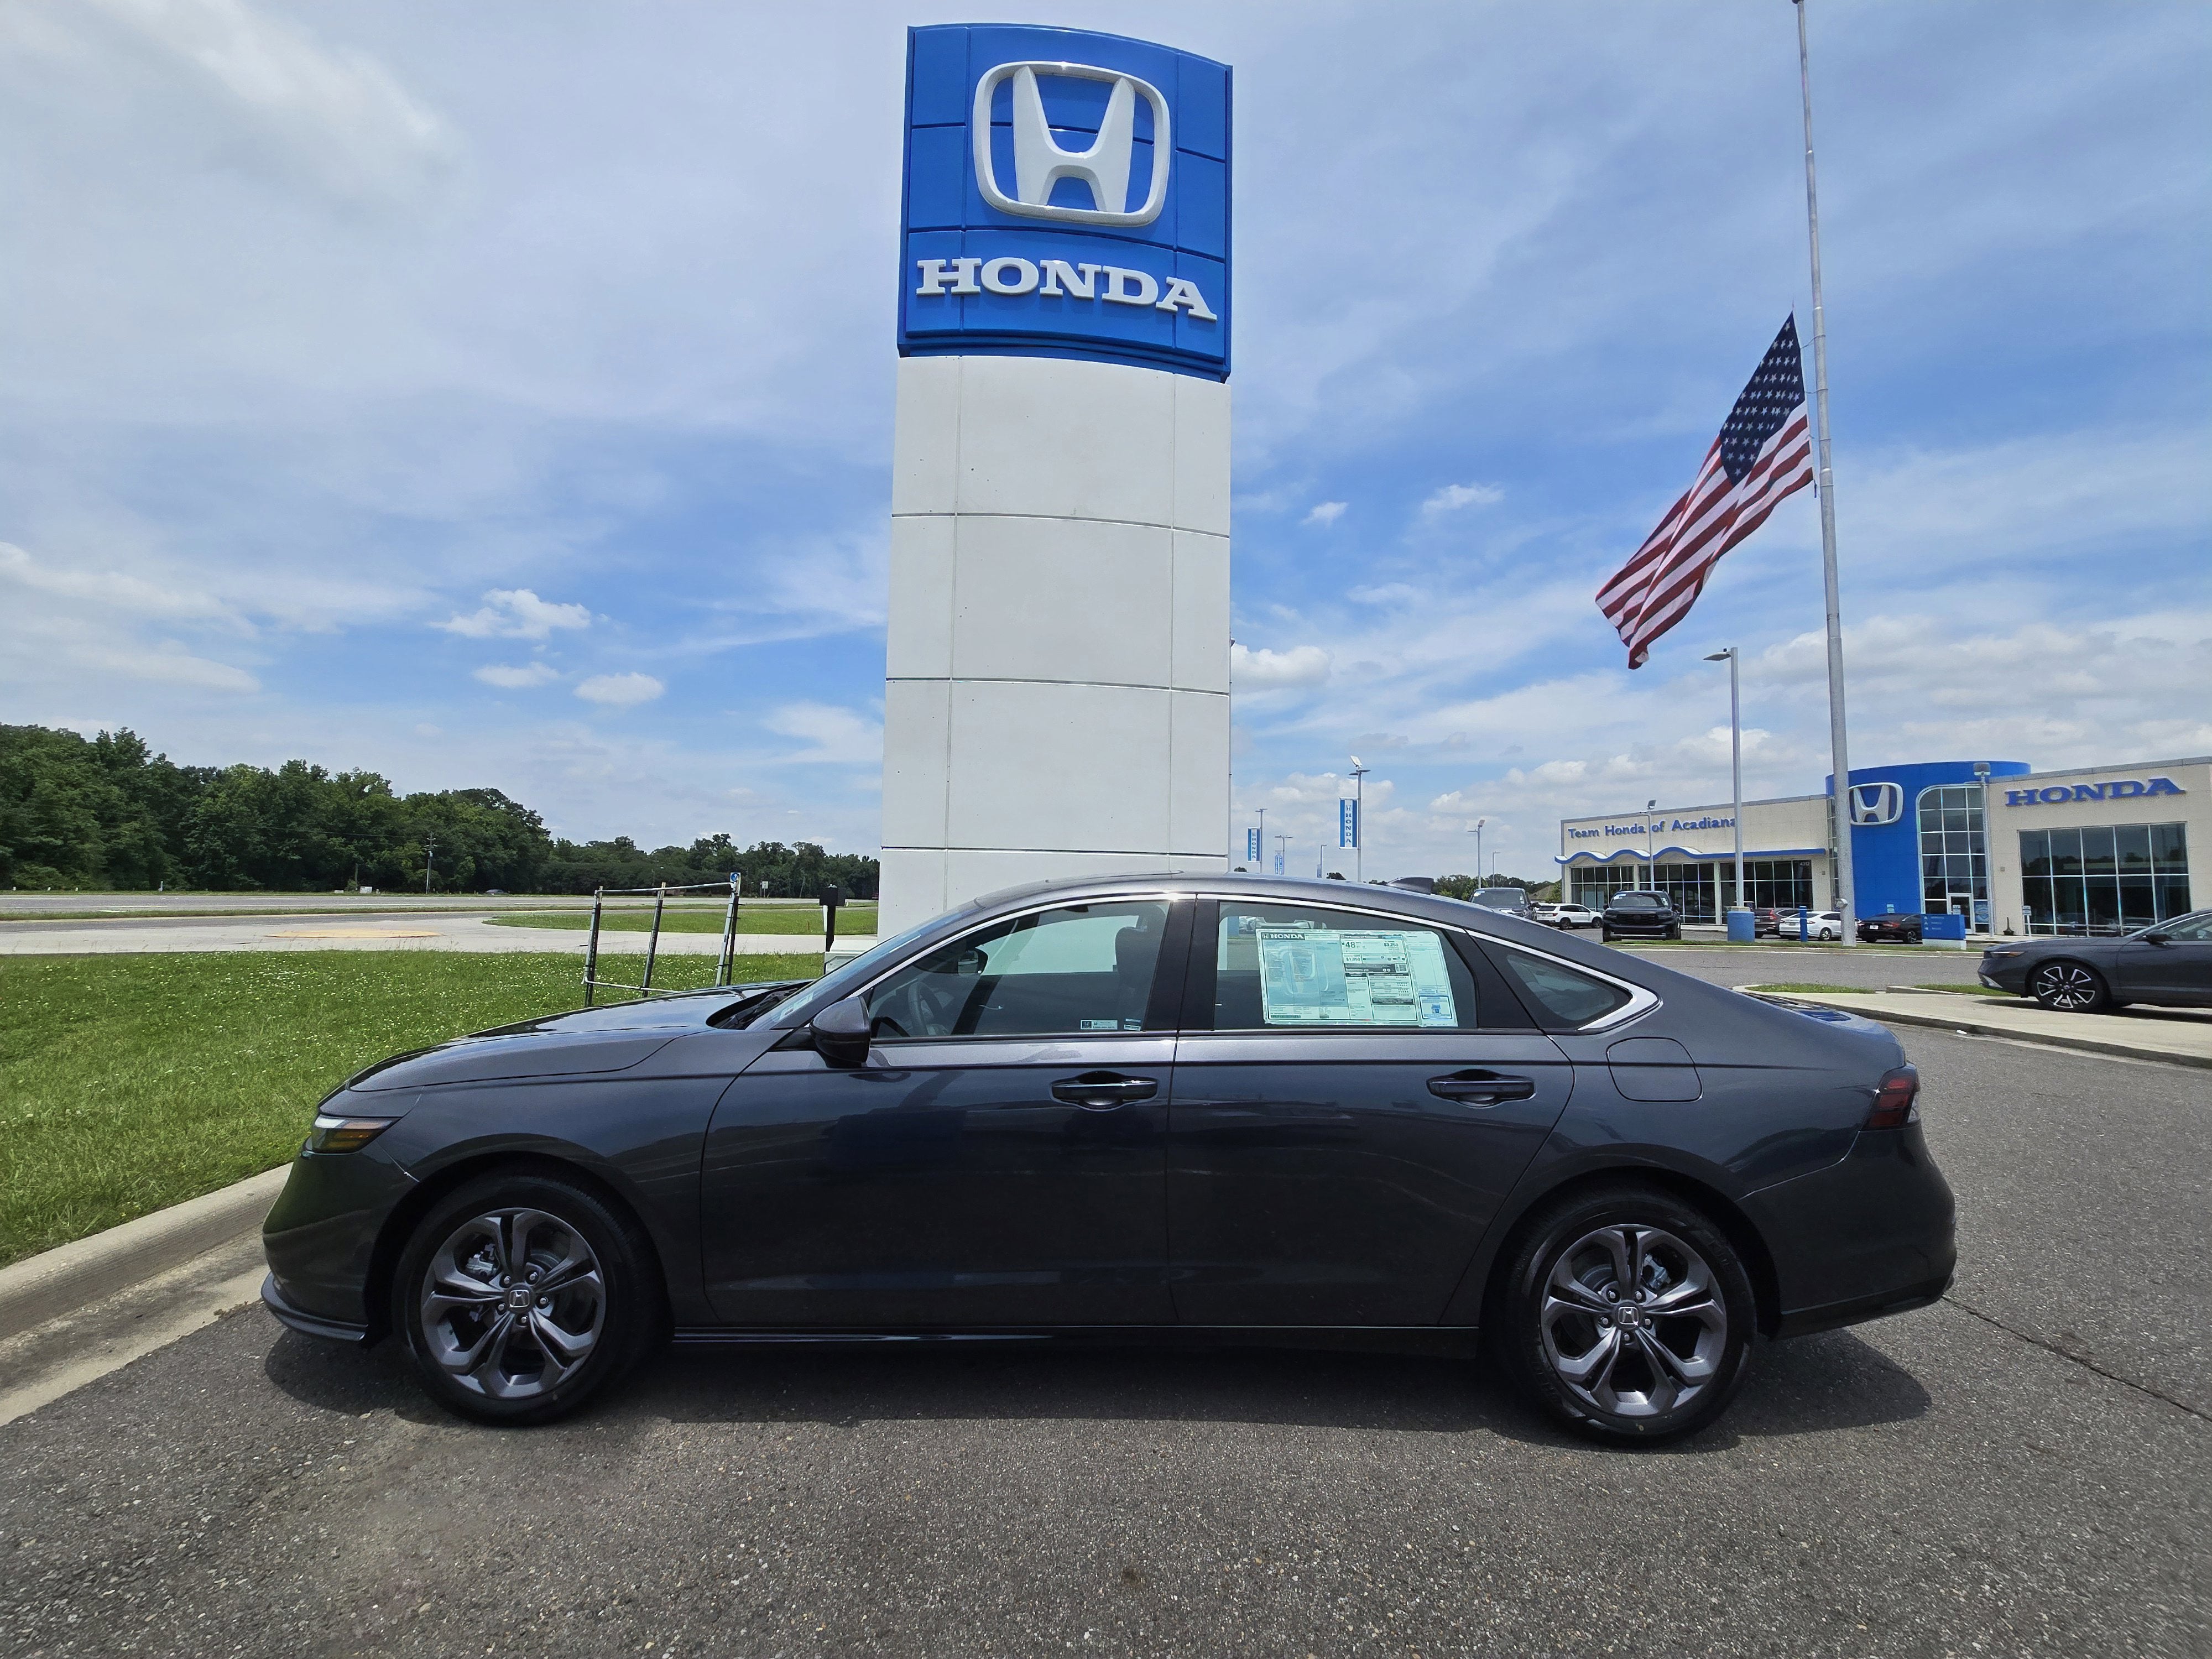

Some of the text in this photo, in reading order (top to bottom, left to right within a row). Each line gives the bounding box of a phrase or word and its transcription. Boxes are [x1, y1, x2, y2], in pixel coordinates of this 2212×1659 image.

[915, 257, 1217, 322] HONDA
[2004, 778, 2187, 807] HONDA
[1568, 827, 1599, 838] Team
[1605, 823, 1646, 837] Honda
[1652, 821, 1665, 833] of
